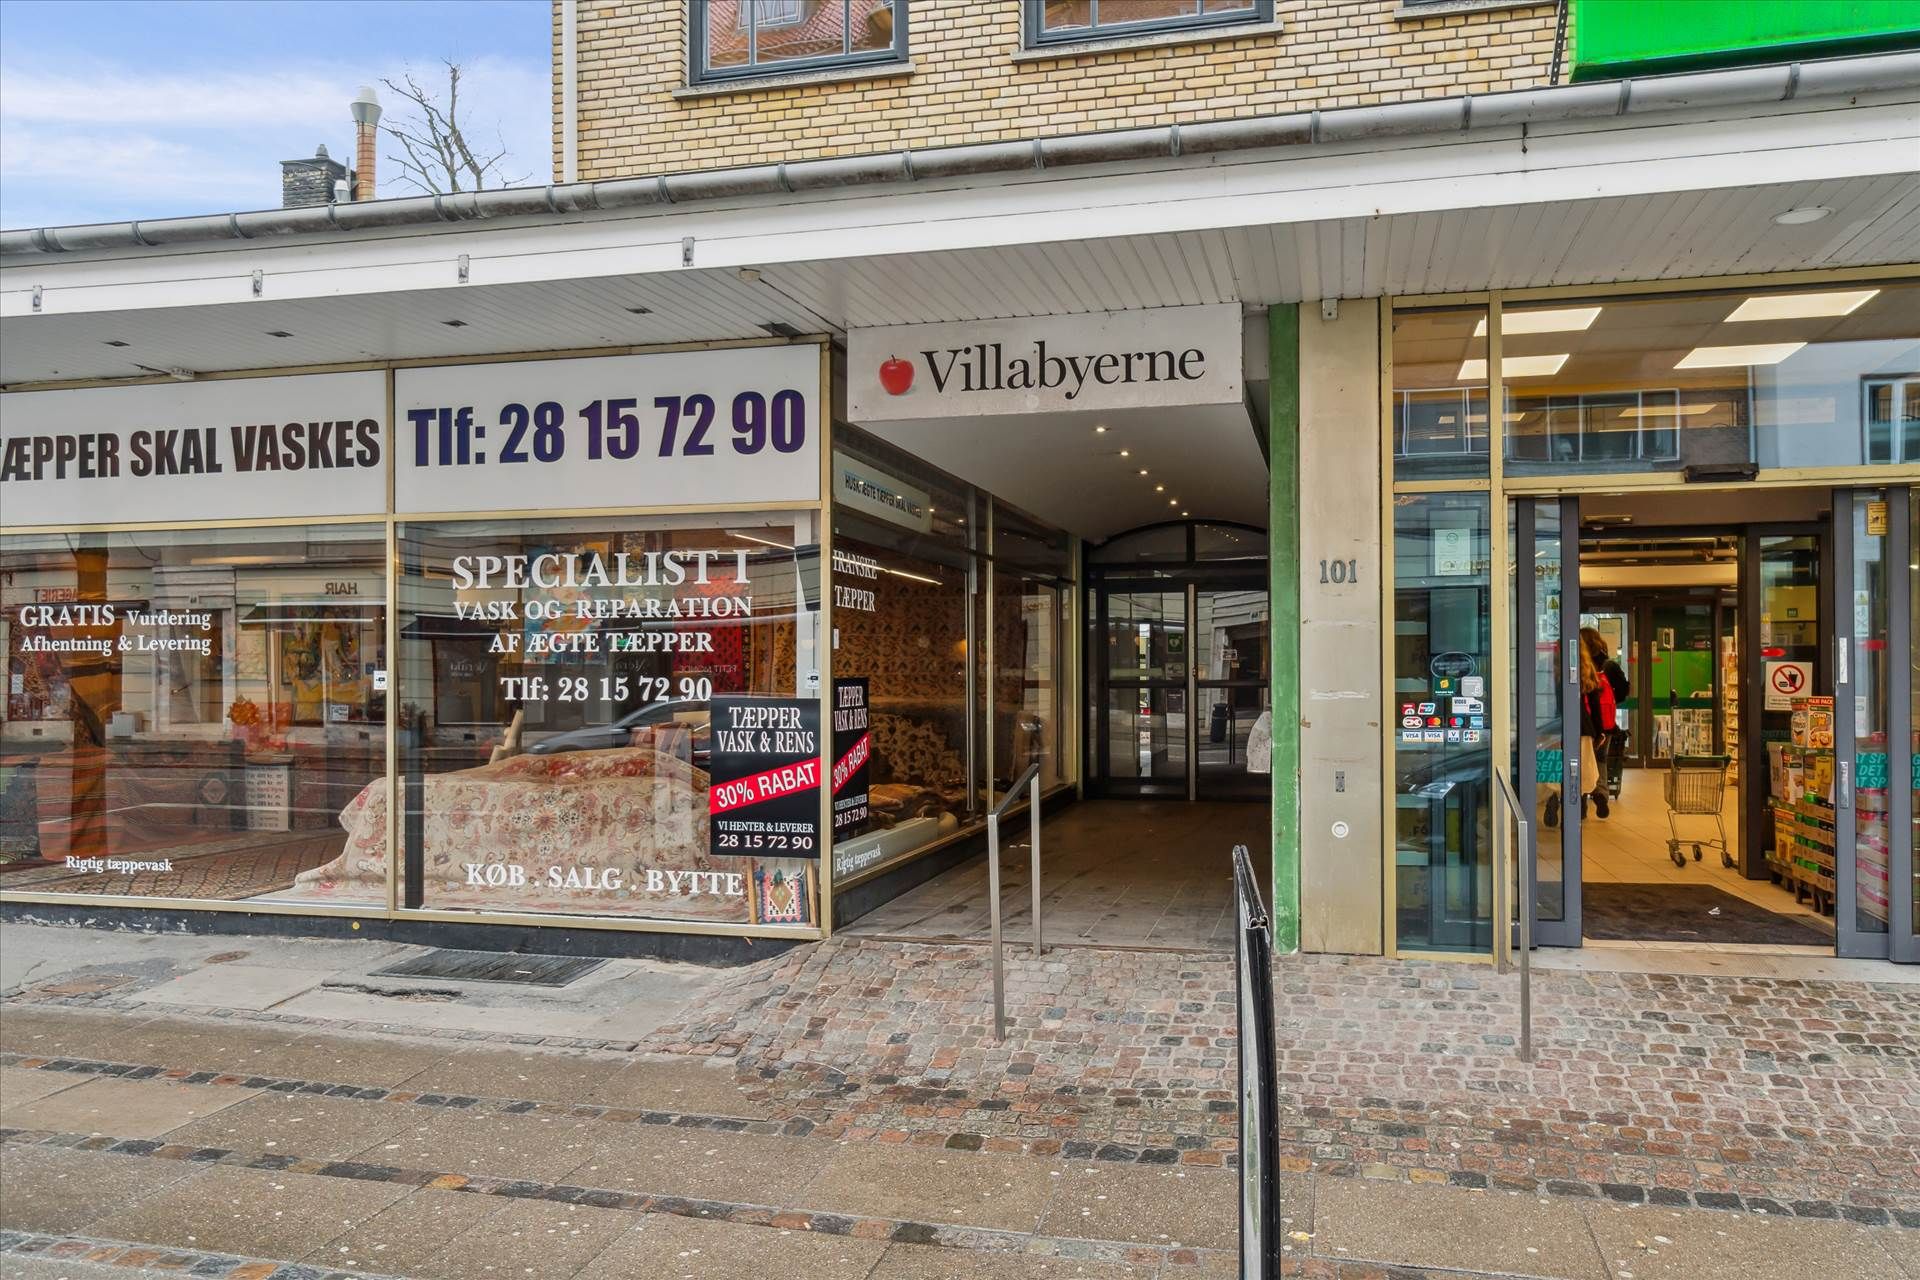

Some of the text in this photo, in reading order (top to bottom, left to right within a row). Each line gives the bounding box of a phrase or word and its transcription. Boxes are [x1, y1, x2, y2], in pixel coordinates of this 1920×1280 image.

[920, 340, 1206, 400] Villabyerne
[408, 389, 806, 468] Tlf: 28 15 72 90
[0, 418, 381, 482] ÆPPER SKAL VASKES
[452, 548, 751, 590] SPECIALIST I
[1319, 559, 1358, 584] 101
[453, 596, 753, 622] VASK OG REPARATION
[834, 585, 876, 612] TÆPPER
[20, 604, 212, 631] GRATIS Vurdering
[21, 635, 212, 657] Afhentning & Levering
[488, 631, 714, 653] AF ÆGTE TÆPPER
[500, 676, 713, 703] Tlf: 28 15 72 90
[838, 686, 864, 707] TÆPPER
[729, 706, 803, 729] TÆPPER
[834, 709, 849, 732] VASK
[854, 707, 868, 729] RENS
[717, 730, 814, 754] VASK & RENS
[833, 737, 868, 788] 30% RABAT
[1859, 764, 1884, 776] DET
[716, 762, 815, 808] 30% RABAT
[718, 821, 814, 833] VI HENTER & LEVERER
[835, 806, 868, 827] 28 15 72 90
[719, 834, 813, 850] 28 15 72 90
[66, 855, 173, 874] Rigtig tæppevask
[465, 862, 526, 887] KØB
[548, 865, 623, 891] SALG
[645, 868, 744, 896] BYTTE
